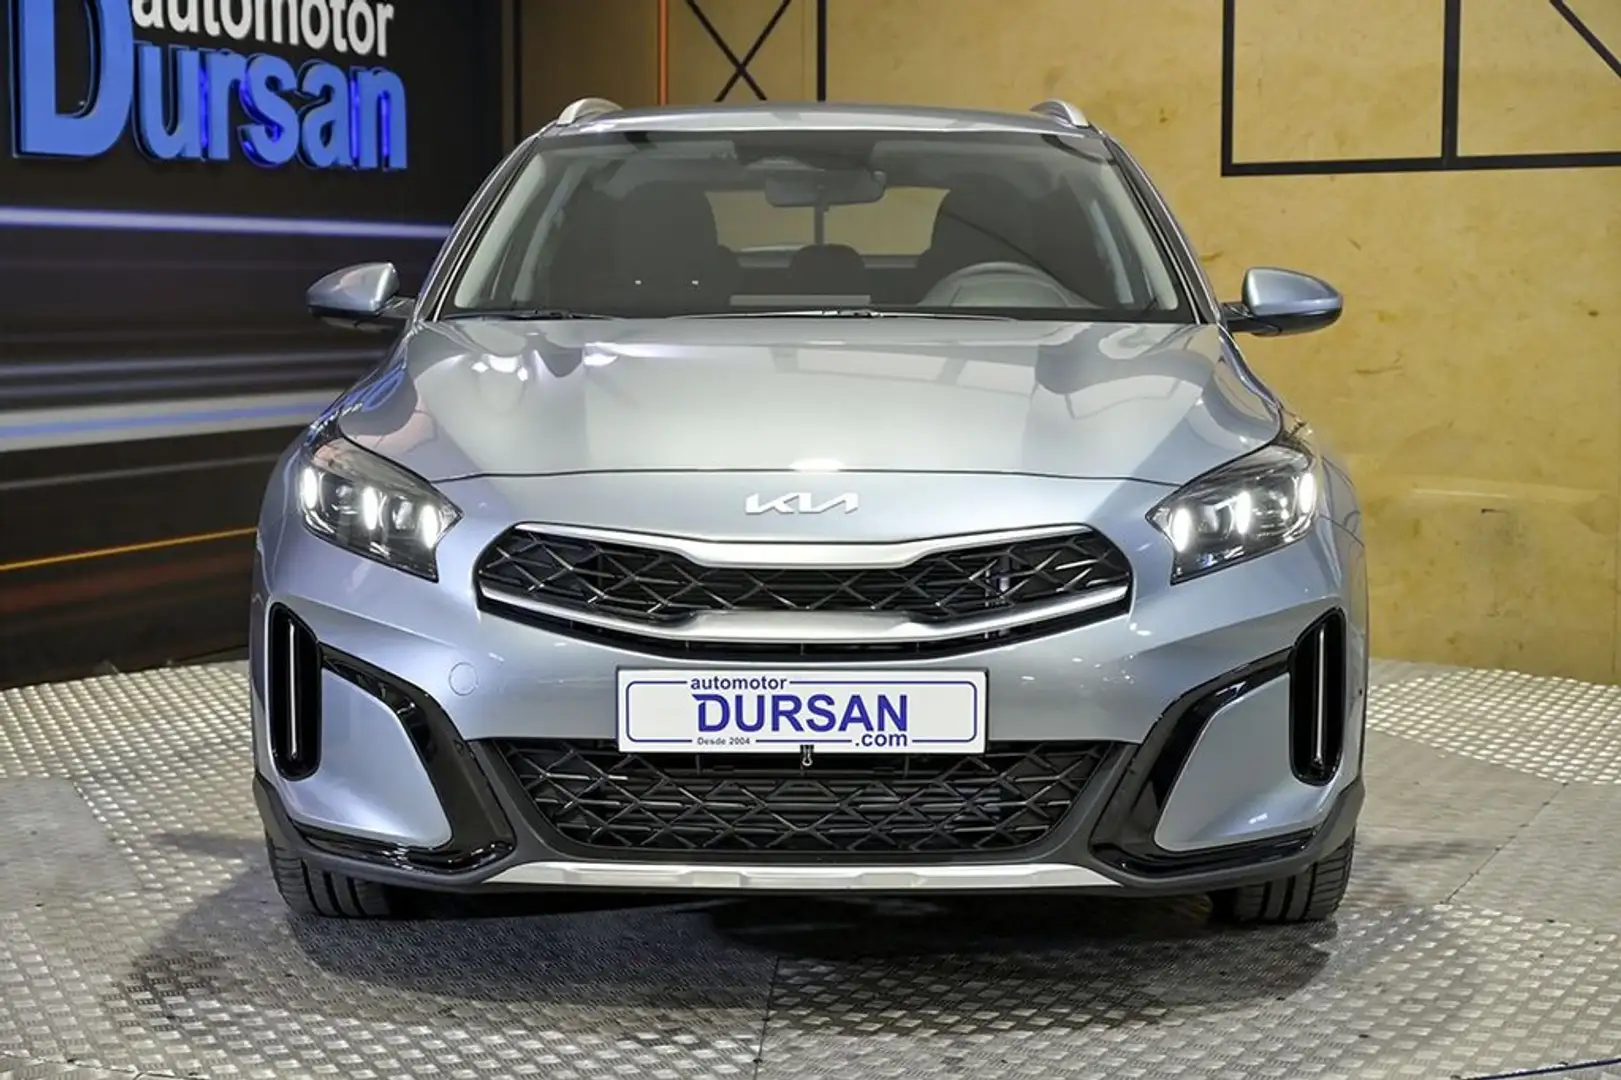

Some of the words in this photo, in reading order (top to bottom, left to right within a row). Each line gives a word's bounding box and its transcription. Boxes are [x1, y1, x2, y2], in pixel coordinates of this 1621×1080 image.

[132, 0, 395, 57] automotor
[12, 0, 408, 170] Dursan
[690, 676, 788, 690] automotor
[692, 694, 908, 732] DURSAN
[697, 736, 726, 746] Desde
[729, 736, 750, 745] 2004
[855, 733, 908, 747] .com
